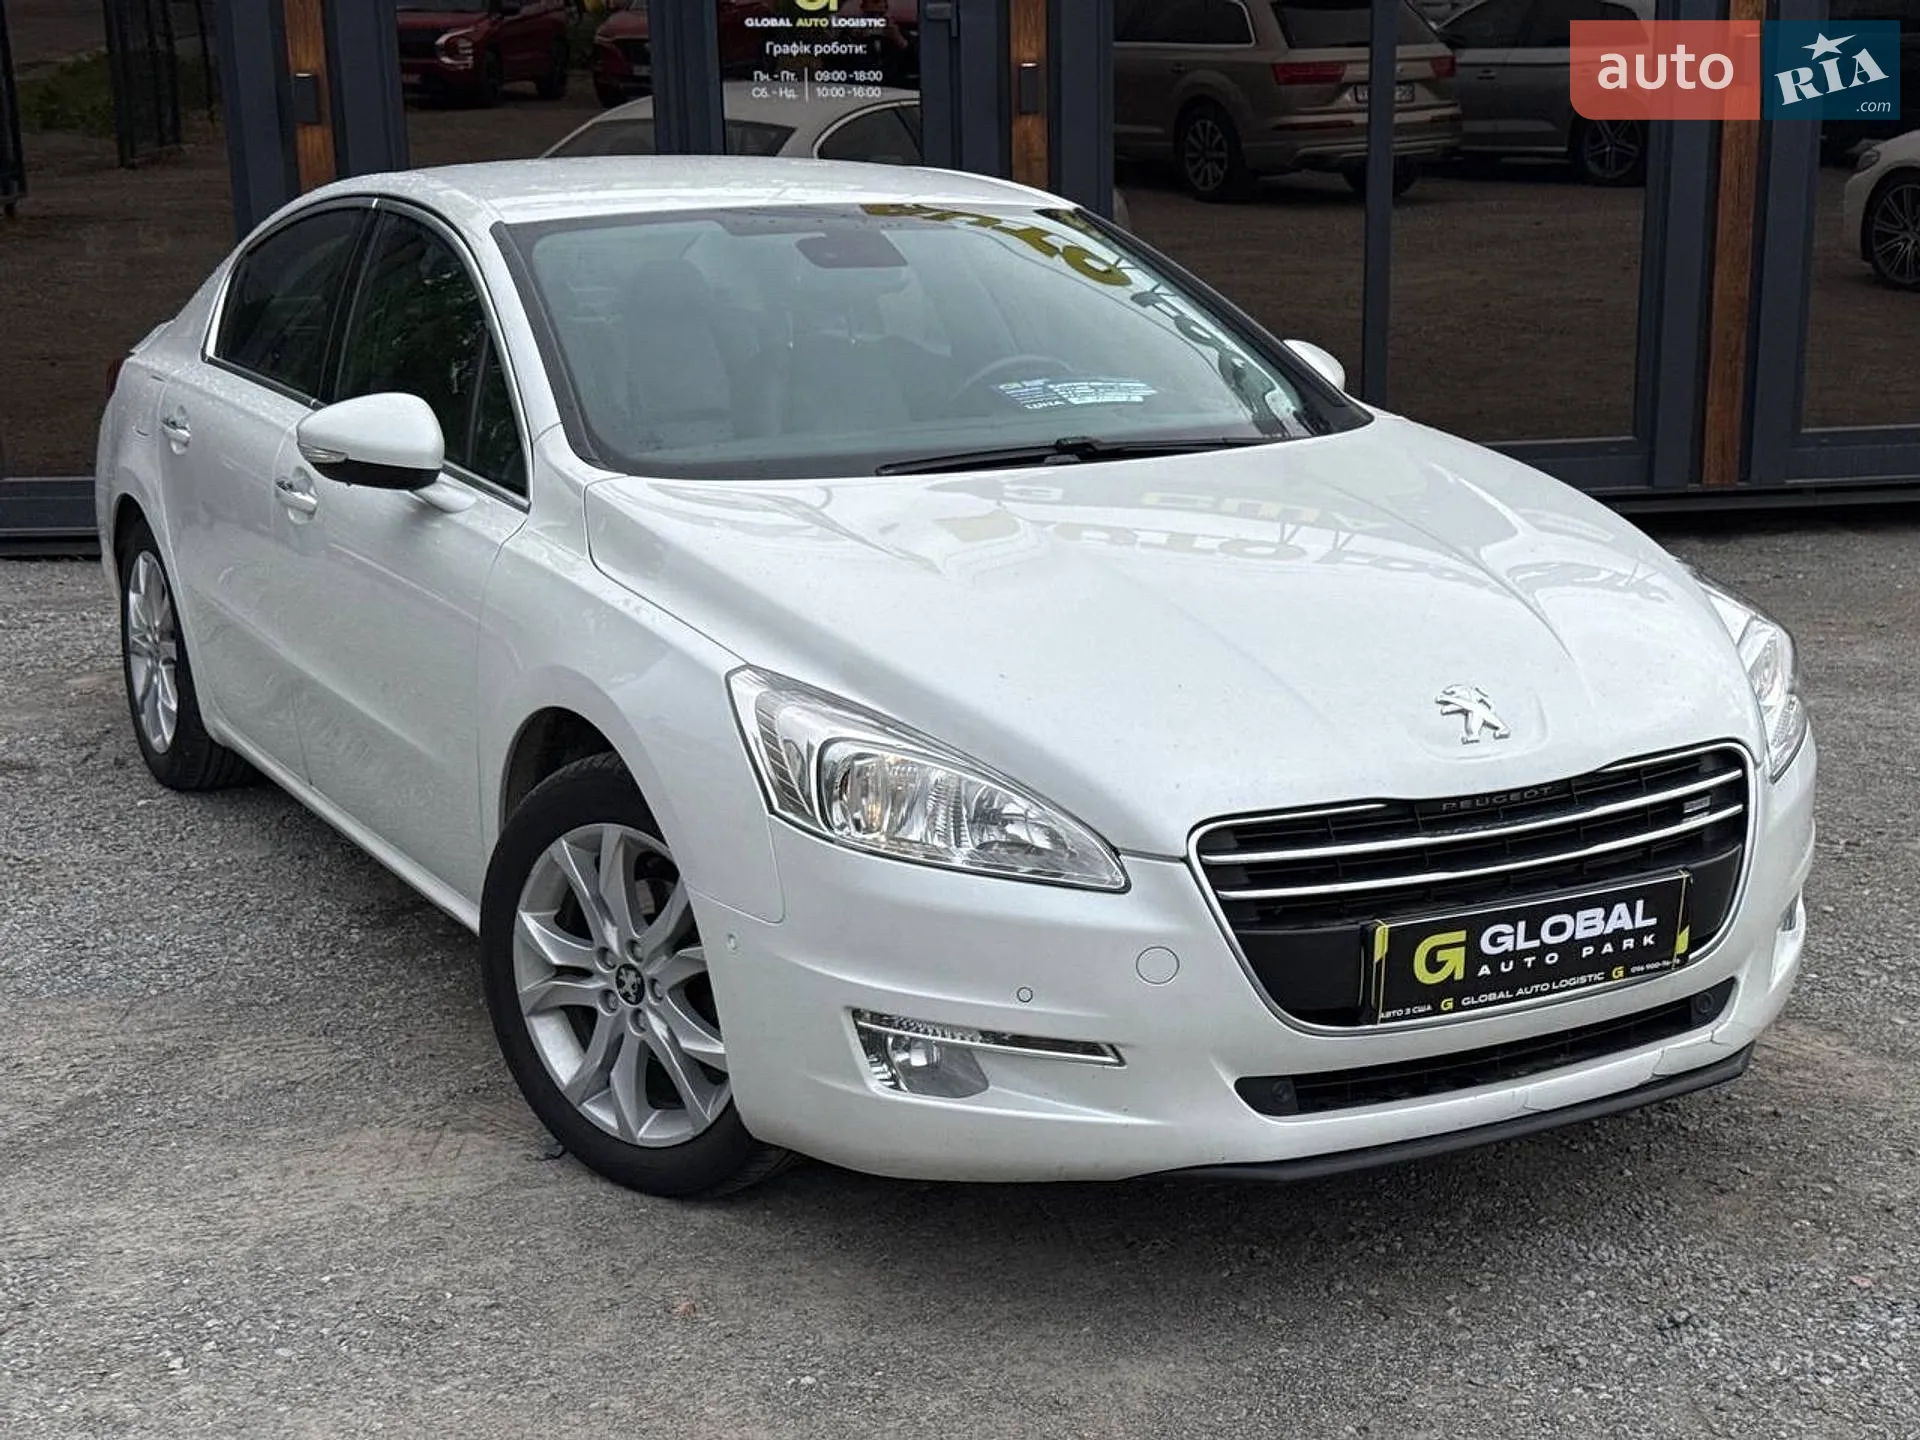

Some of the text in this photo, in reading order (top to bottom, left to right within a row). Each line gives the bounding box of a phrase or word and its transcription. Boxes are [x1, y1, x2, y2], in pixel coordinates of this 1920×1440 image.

[745, 17, 887, 28] GLOBAL AUTO LOGISTIC
[765, 41, 868, 56] Графік роботи:
[1442, 785, 1553, 811] PEUGEOT
[1480, 899, 1657, 955] GLOBAL
[1477, 933, 1656, 977] AUTO PARK
[1461, 990, 1513, 1006] GLOBAL
[1515, 982, 1550, 996] AUTO
[1552, 971, 1605, 990] LOGISTIC
